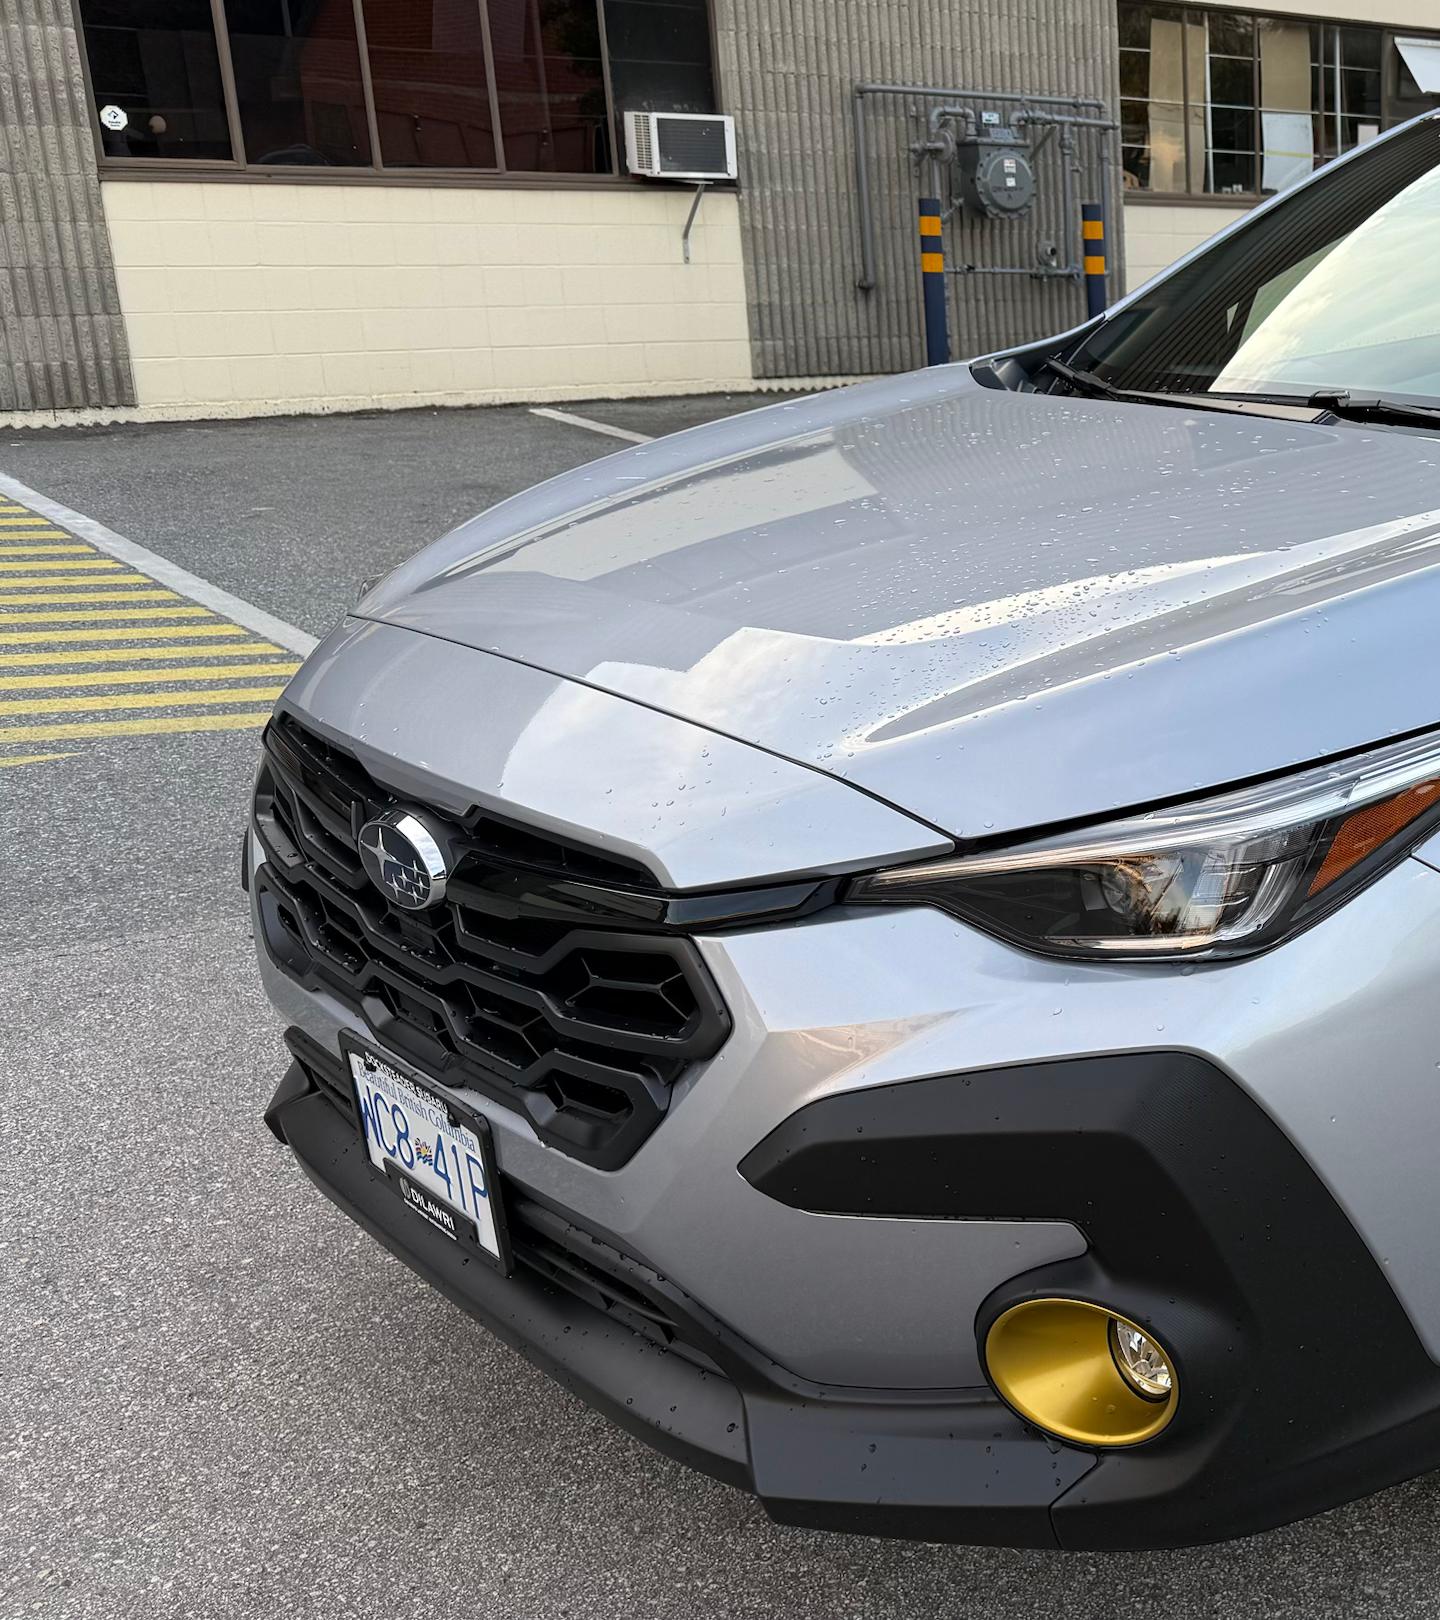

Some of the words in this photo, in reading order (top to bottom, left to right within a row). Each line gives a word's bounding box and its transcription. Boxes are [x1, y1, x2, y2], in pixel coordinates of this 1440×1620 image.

[397, 1087, 428, 1121] British
[428, 1108, 476, 1153] Columbia
[415, 1086, 449, 1114] SUBARU
[433, 1133, 488, 1220] 41P
[410, 1188, 455, 1231] DILAWRI
